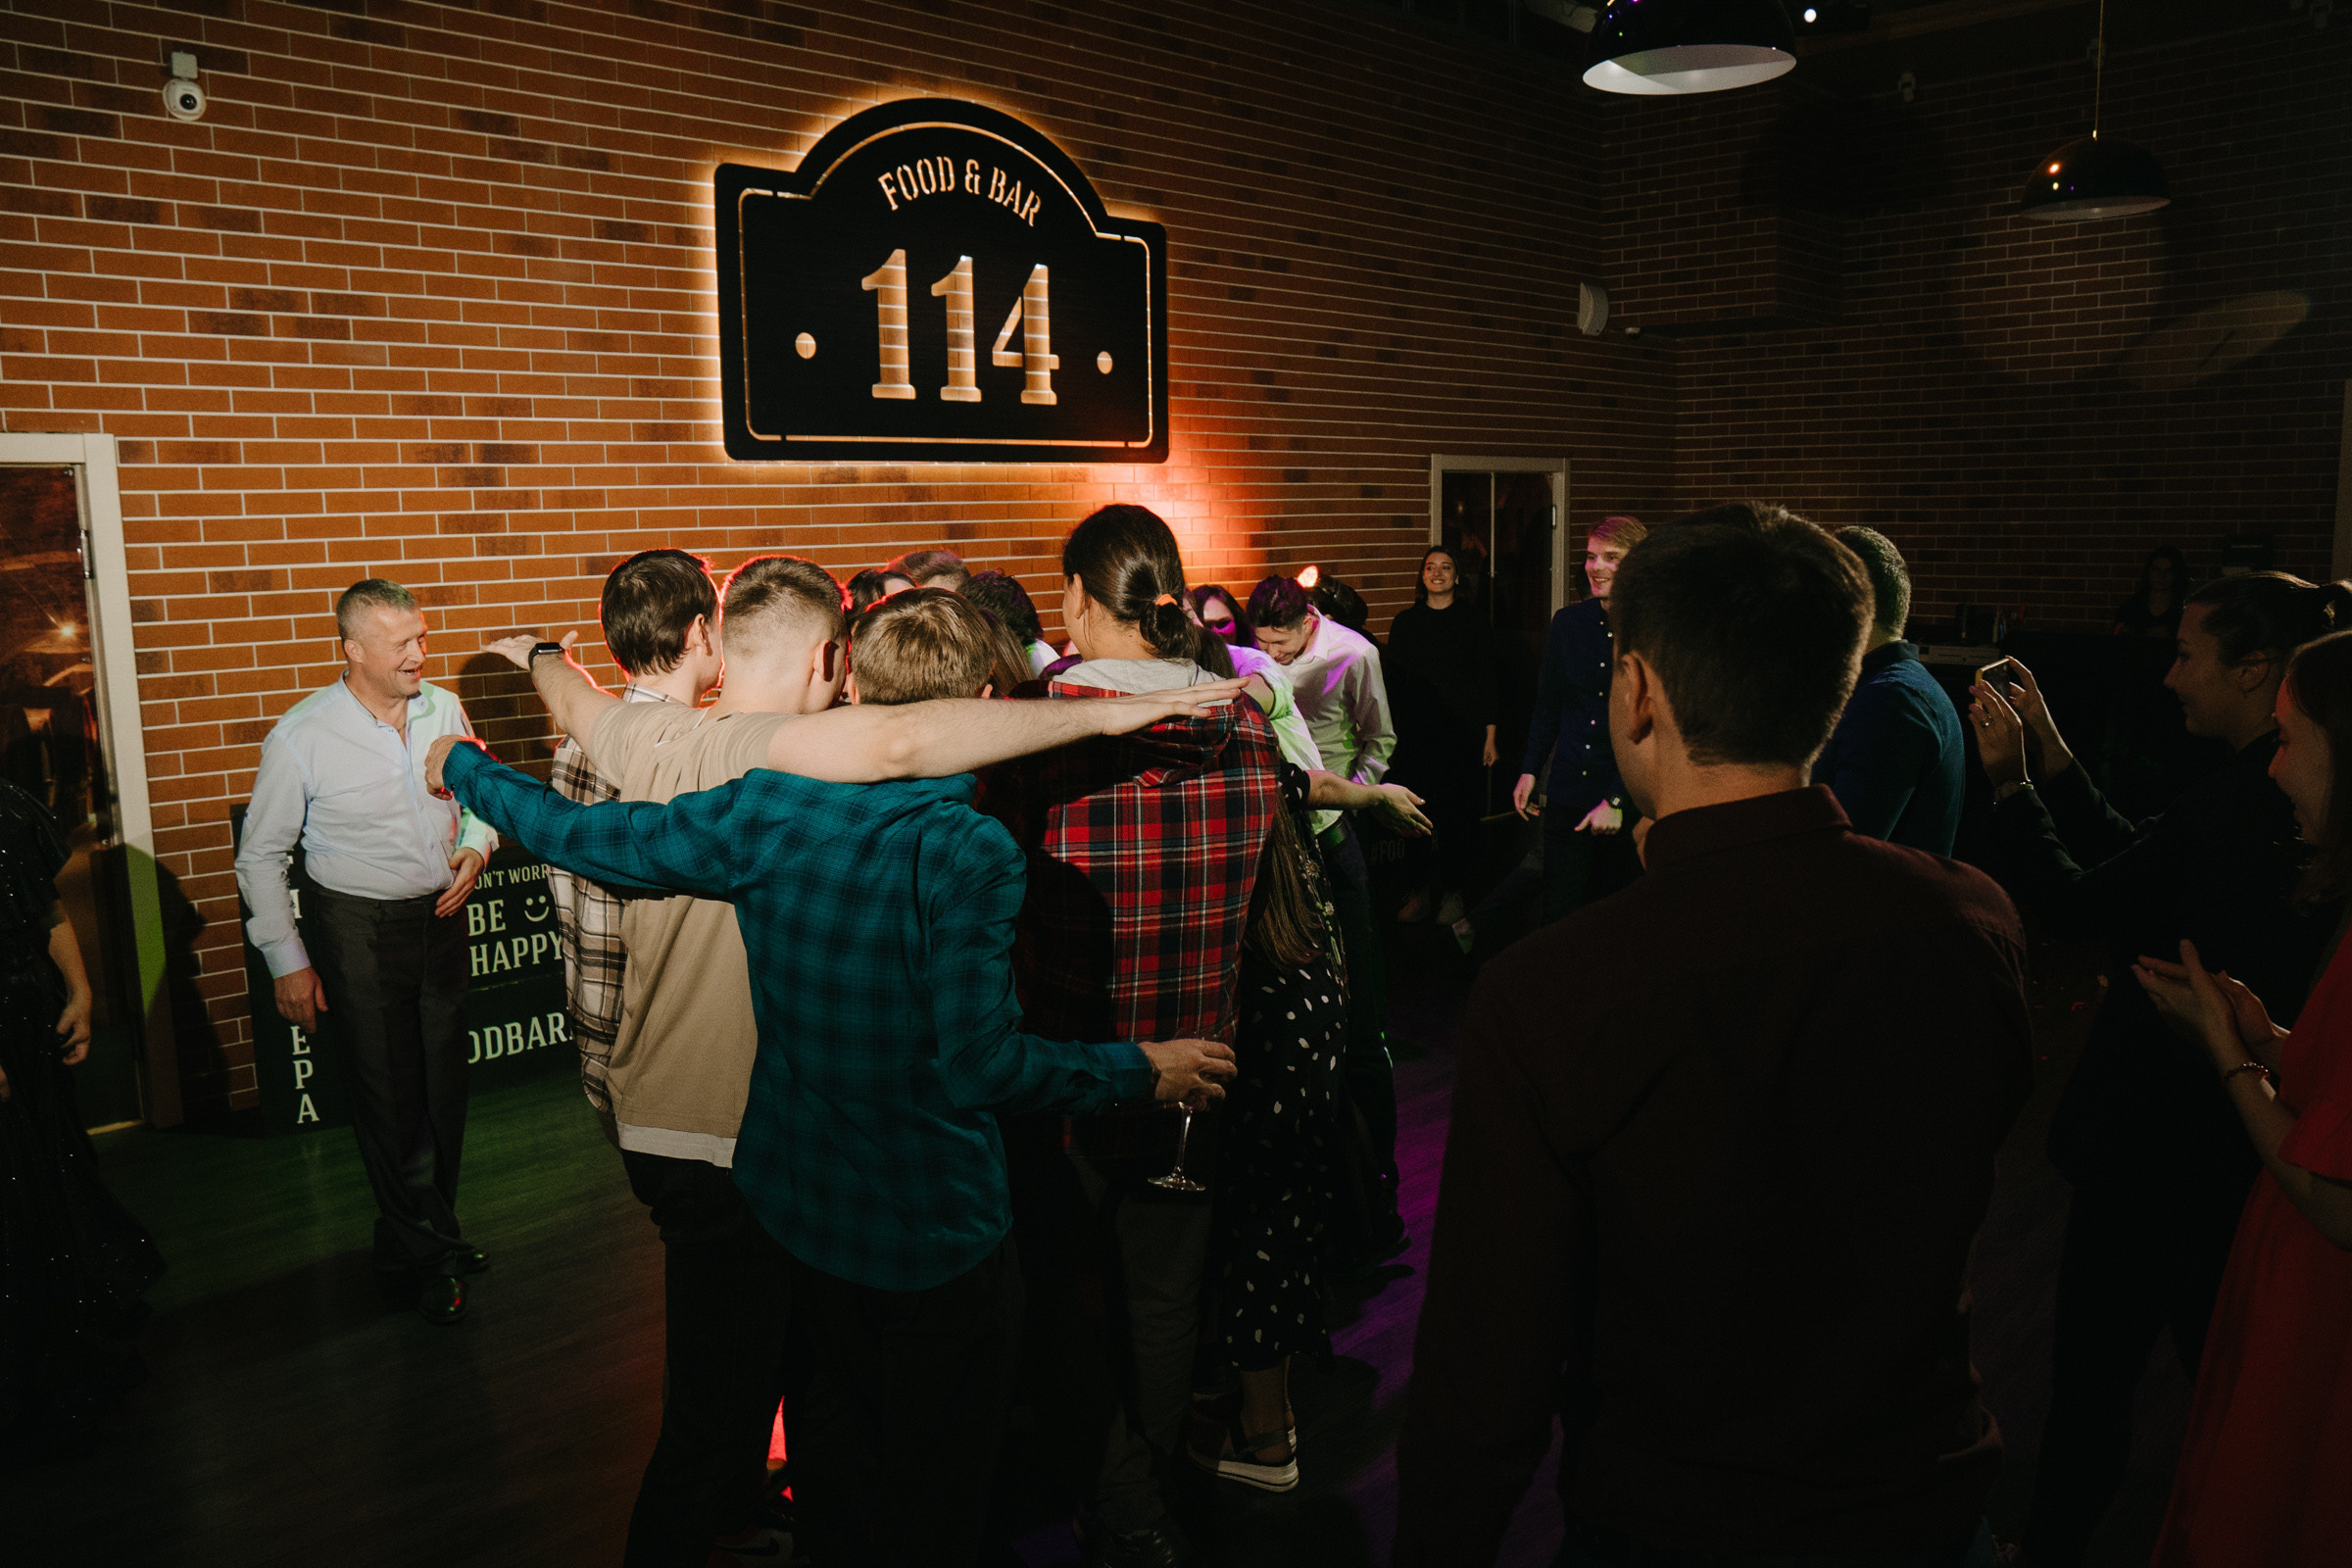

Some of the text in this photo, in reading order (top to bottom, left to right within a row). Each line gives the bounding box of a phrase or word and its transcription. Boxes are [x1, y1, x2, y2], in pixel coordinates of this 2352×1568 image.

[878, 156, 1042, 226] FOOD & BAR
[861, 248, 1059, 405] 114
[474, 863, 548, 890] ON'T WORR
[466, 898, 507, 937] BE
[469, 930, 564, 977] HAPPY
